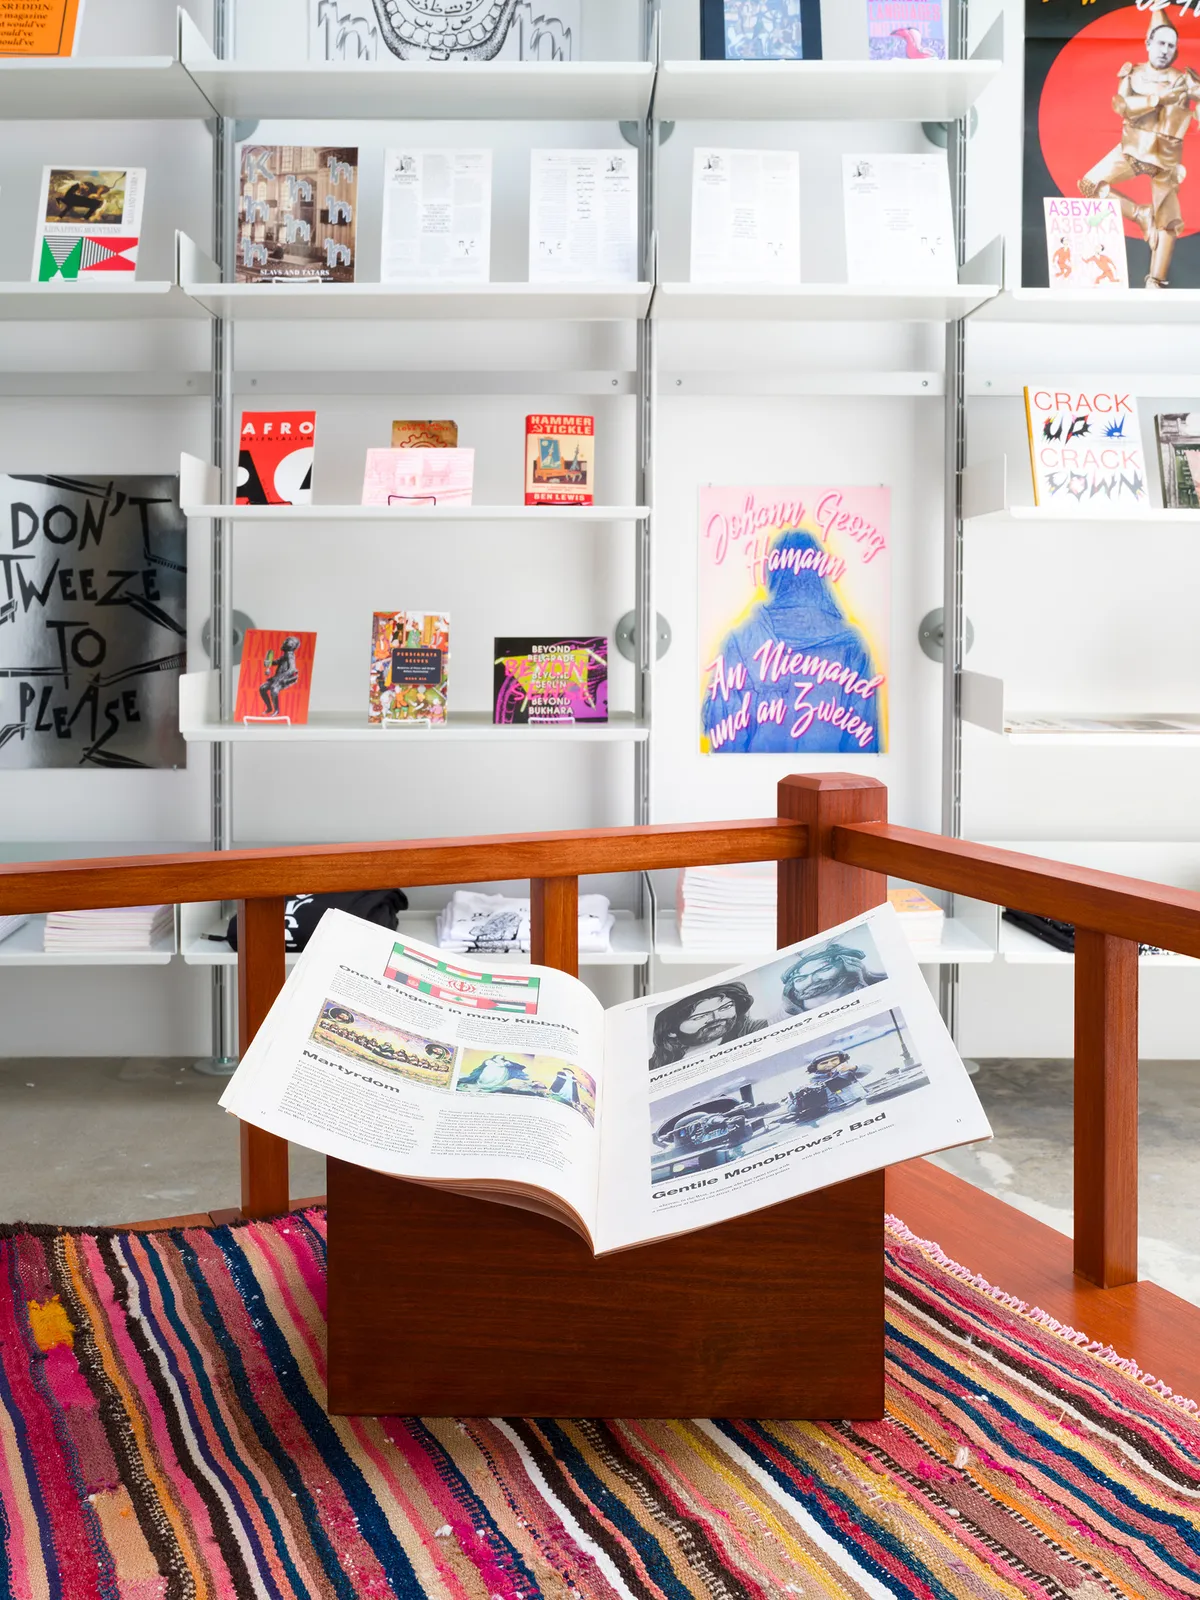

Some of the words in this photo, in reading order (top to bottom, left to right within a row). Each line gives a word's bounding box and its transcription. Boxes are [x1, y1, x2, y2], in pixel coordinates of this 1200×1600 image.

[868, 3, 941, 22] LANGUAGES
[0, 38, 35, 46] ould've
[1048, 200, 1118, 217] АЗБУКА
[84, 226, 122, 235] MOUNTAINS
[1034, 391, 1133, 413] CRACK
[242, 421, 314, 435] AFRO
[530, 416, 592, 426] HAMMER
[545, 425, 592, 435] TICKLE
[1040, 447, 1140, 470] CRACK
[555, 493, 585, 501] LEWIS
[10, 481, 172, 566] DON'T
[706, 493, 805, 565] Johann
[816, 490, 887, 564] Georg
[746, 534, 848, 587] Hamann
[0, 554, 161, 613] TWEEZE
[46, 620, 107, 690] TO
[531, 645, 570, 653] BEYOND
[706, 654, 748, 701] An
[753, 638, 885, 699] Niemand
[528, 706, 574, 715] BUKHARA
[531, 697, 570, 706] BEYOND
[19, 673, 141, 764] PLEASE
[709, 692, 750, 748] und
[756, 697, 787, 724] an
[790, 681, 874, 747] Zweien
[339, 964, 382, 985] One's
[386, 984, 444, 1010] Fingers
[466, 1012, 510, 1023] many
[514, 1017, 579, 1035] Kibbehs
[650, 1059, 705, 1083] Muslim
[709, 1017, 813, 1060] Monobrows?
[817, 999, 861, 1019] Good
[302, 1049, 400, 1094] Martyrdom
[651, 1177, 719, 1200] Gentile
[723, 1128, 844, 1180] Monobrows?
[848, 1112, 887, 1132] Bad
